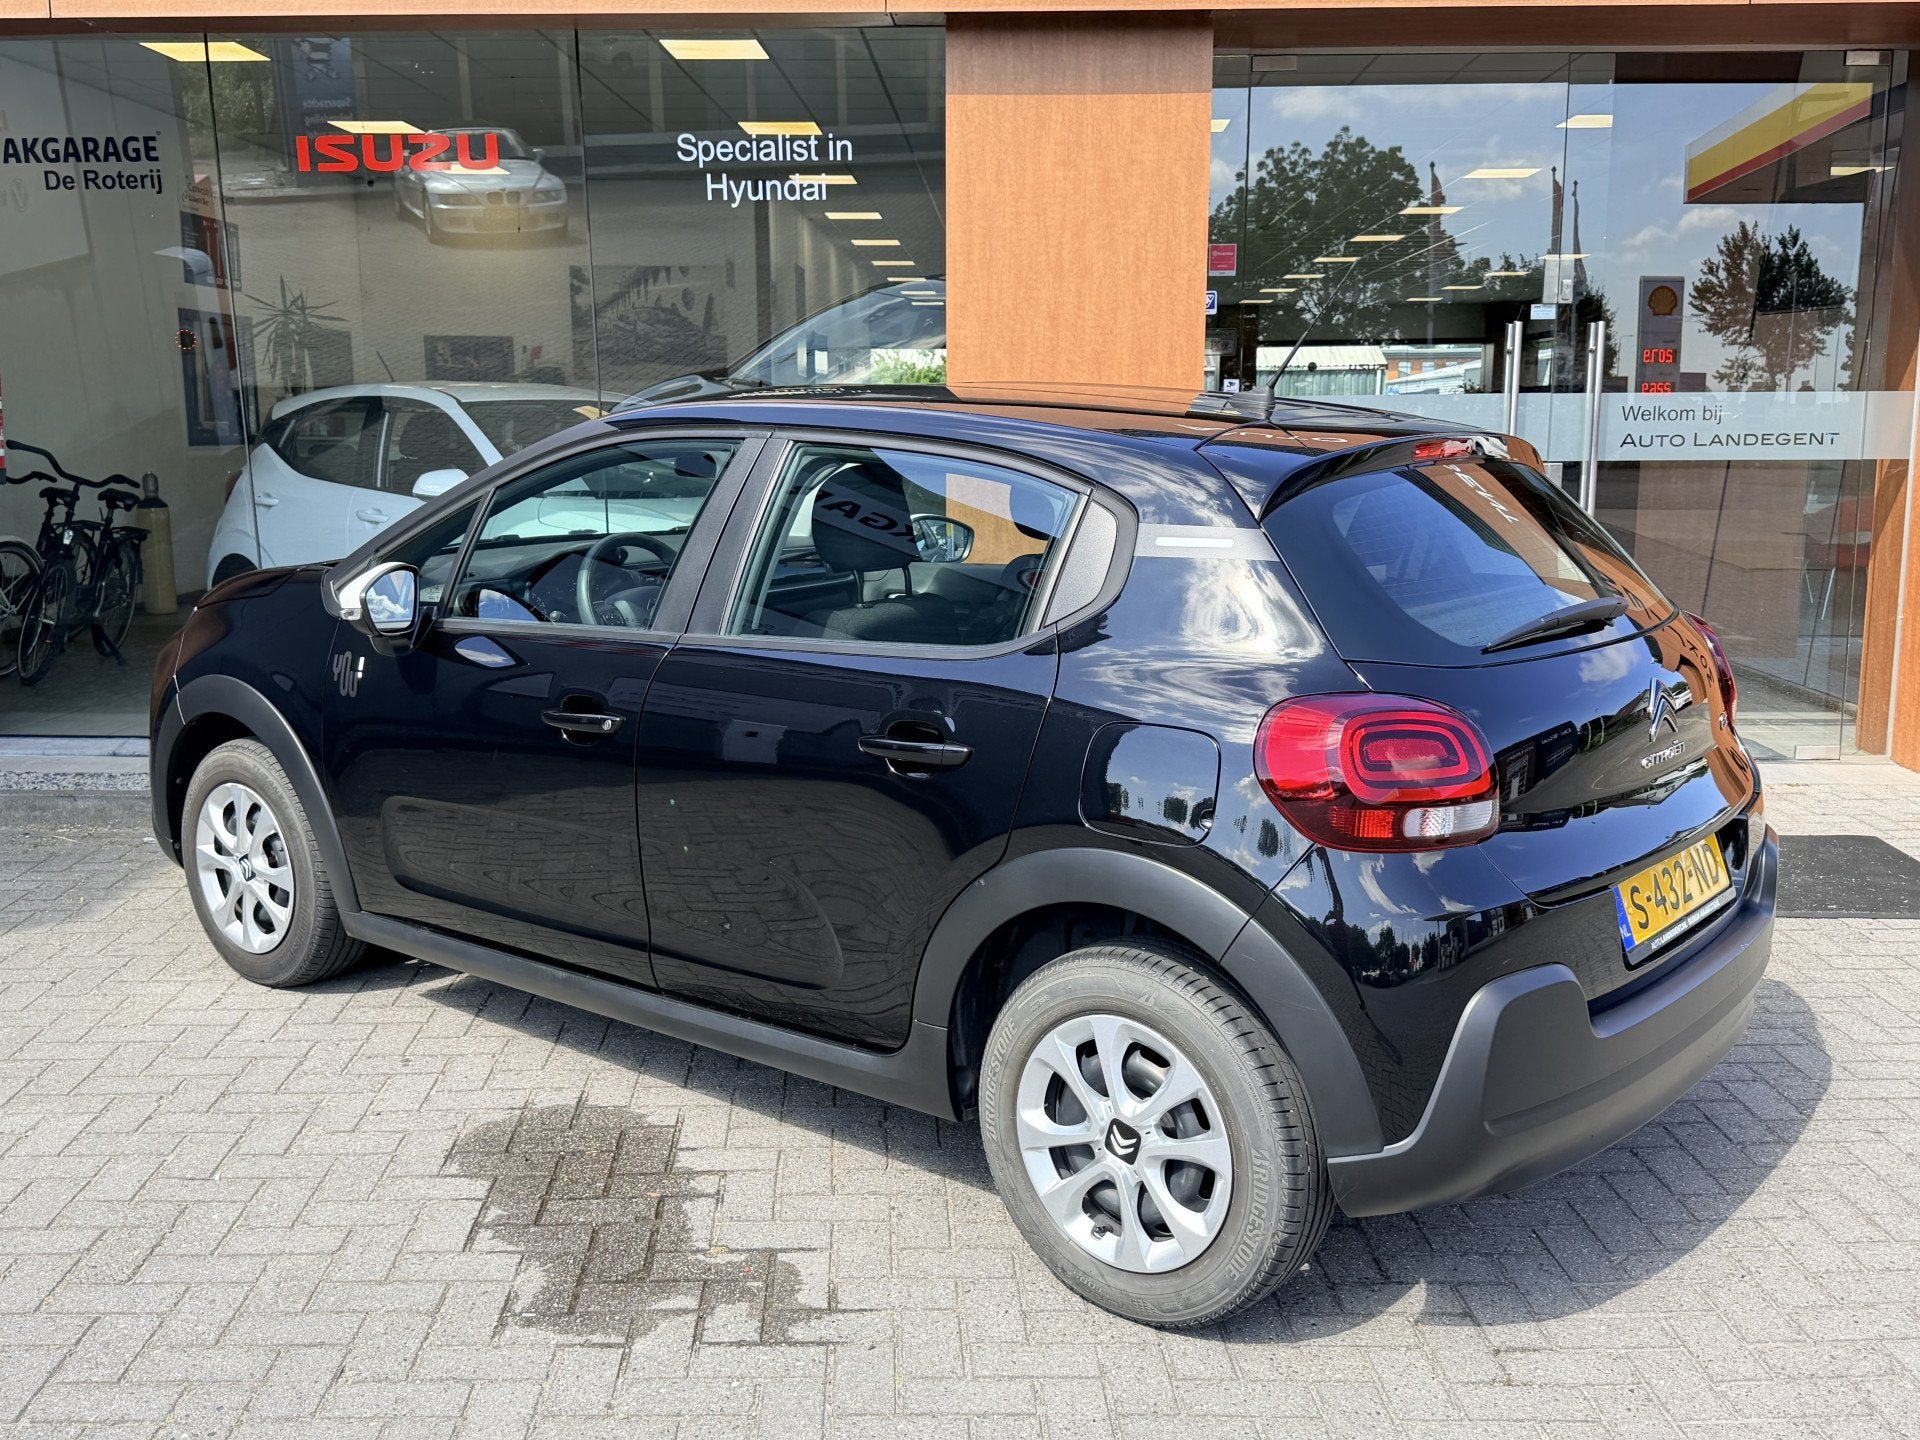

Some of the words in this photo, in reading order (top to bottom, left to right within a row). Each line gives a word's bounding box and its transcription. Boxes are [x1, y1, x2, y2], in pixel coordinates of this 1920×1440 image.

[296, 134, 500, 172] ISUZU
[677, 133, 819, 168] Specialist
[828, 133, 853, 161] in
[44, 171, 76, 190] De
[83, 169, 163, 194] Roterij
[706, 173, 827, 208] Hyundai
[1622, 405, 1696, 422] Welkom
[1702, 405, 1723, 425] bij
[1620, 433, 1686, 448] AUTO
[1693, 431, 1841, 447] LANDEGENT
[1640, 739, 1686, 770] CITROËN
[1629, 843, 1720, 930] S-432-ND
[1619, 923, 1632, 941] NL
[985, 1017, 1018, 1143] BRIDGESTONE
[1224, 1147, 1271, 1282] BRIDGESTONE
